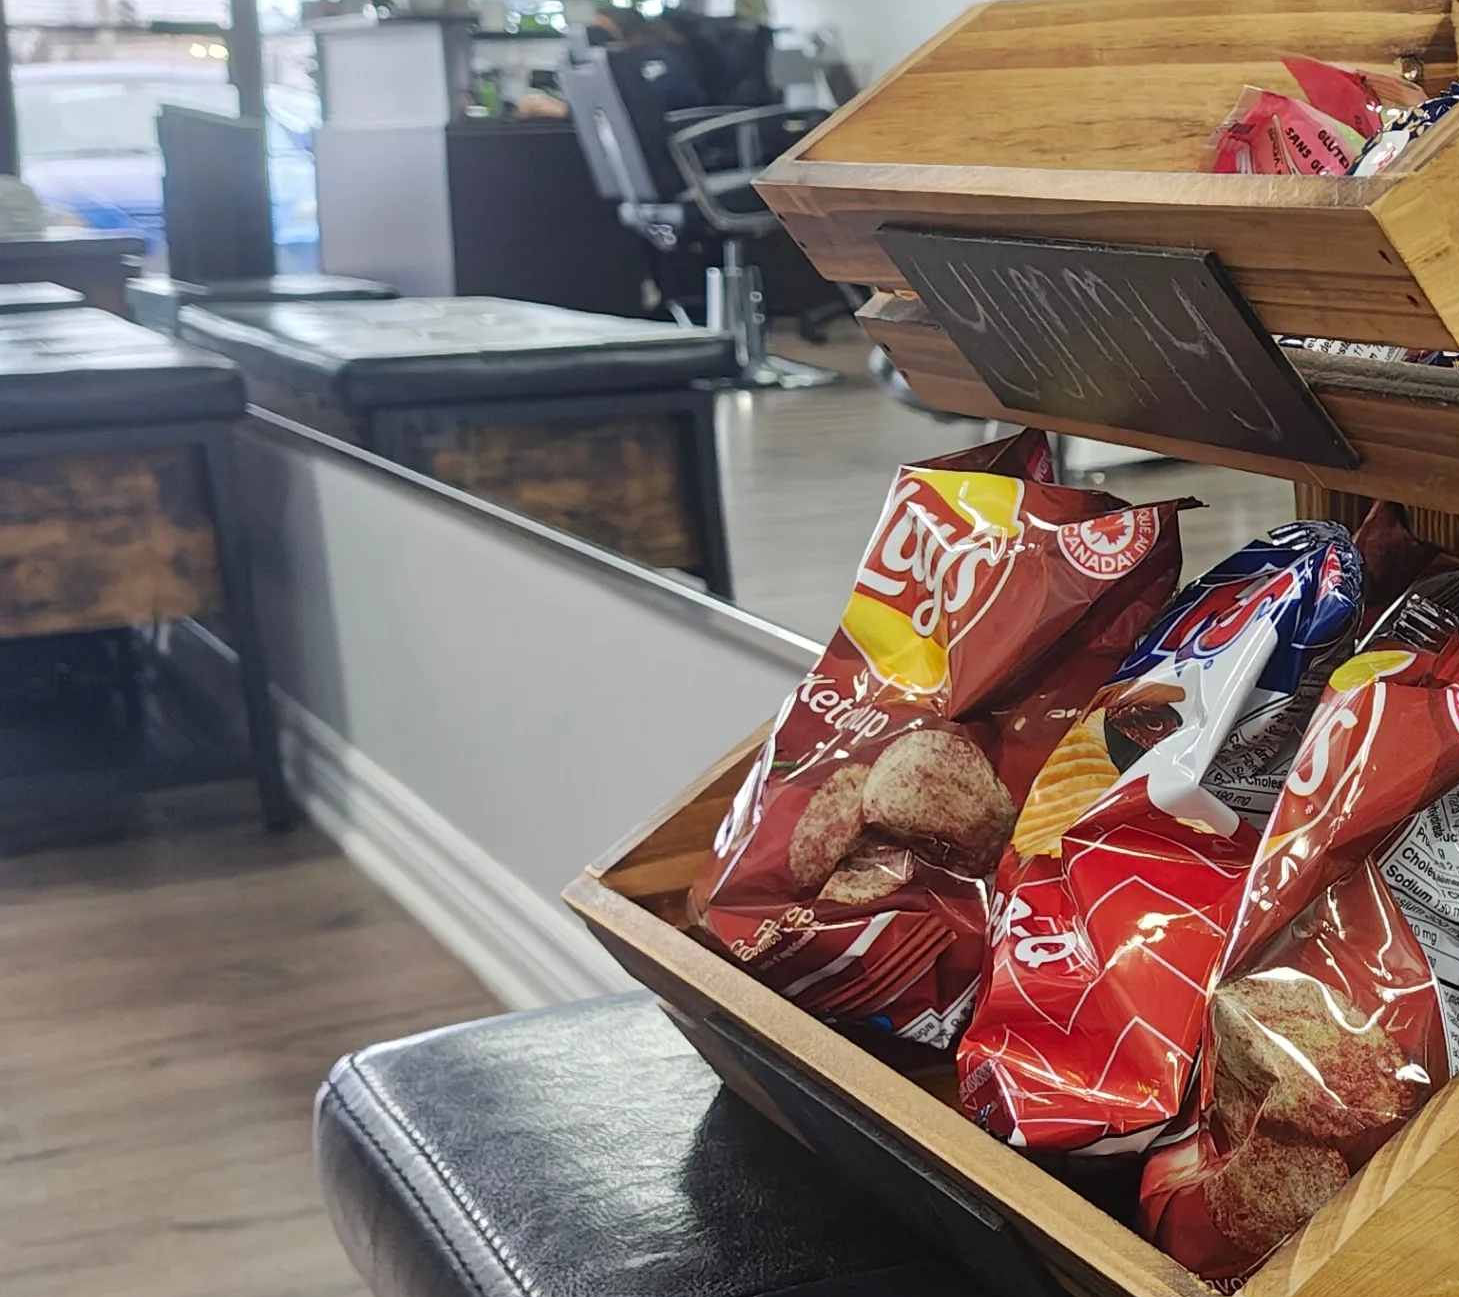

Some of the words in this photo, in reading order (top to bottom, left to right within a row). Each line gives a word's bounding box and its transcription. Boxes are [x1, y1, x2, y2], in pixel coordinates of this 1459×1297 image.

[1285, 127, 1312, 159] SANS
[1386, 864, 1433, 903] Sodium
[1422, 928, 1438, 945] mg
